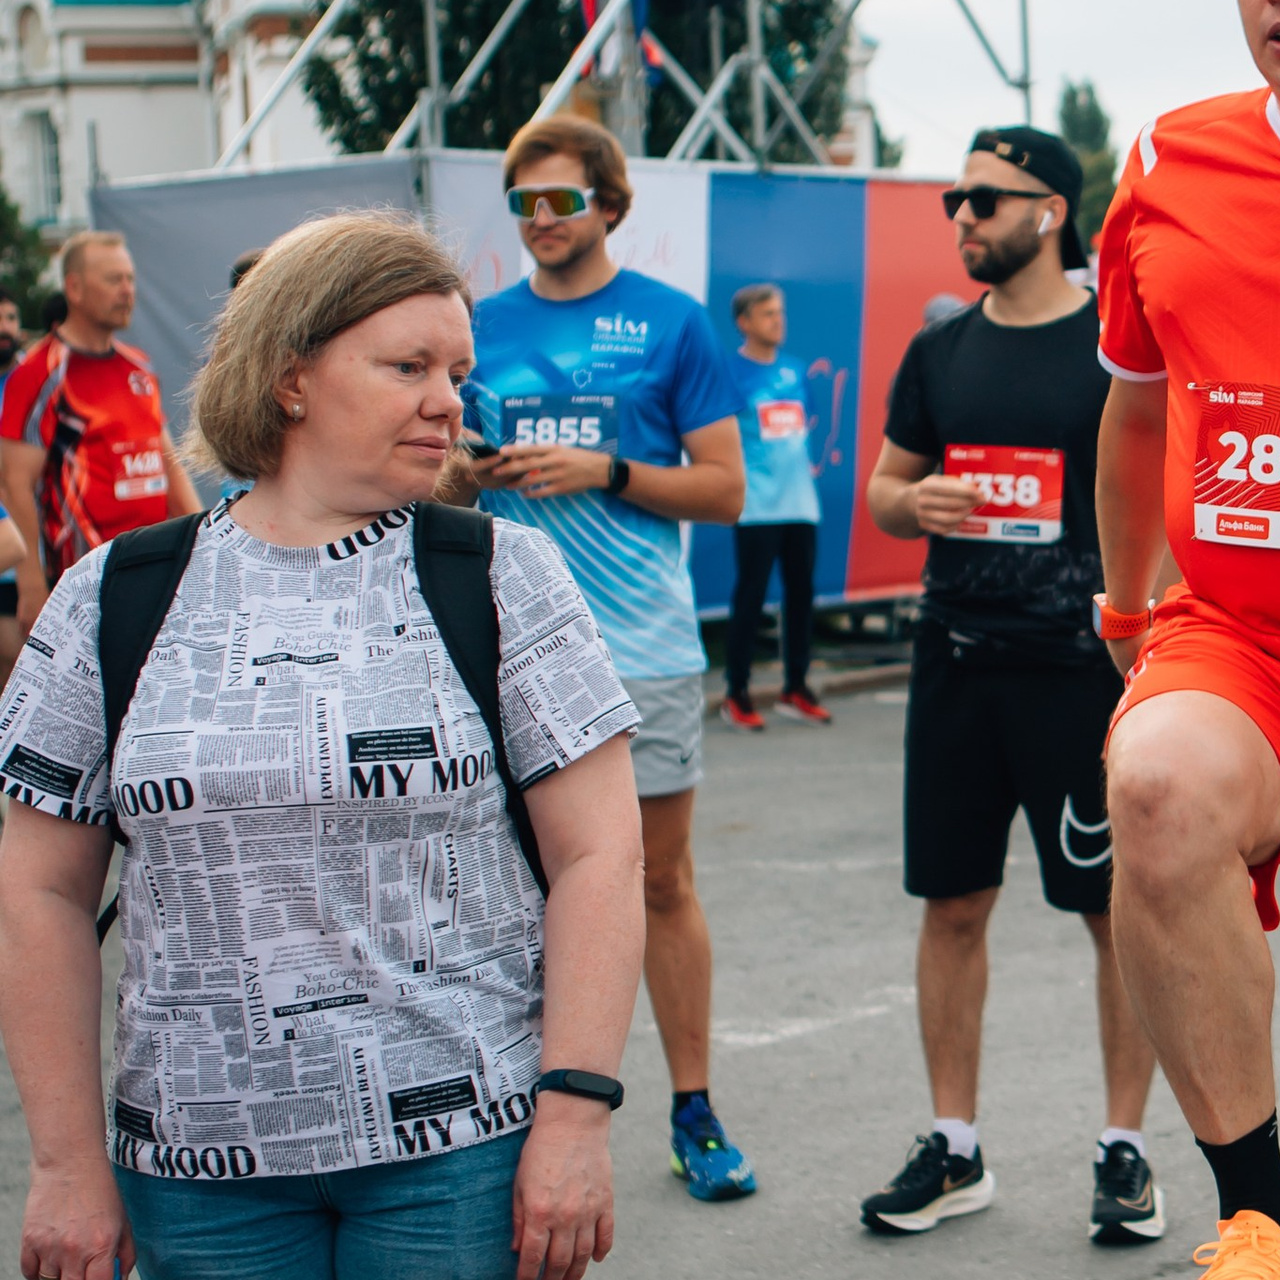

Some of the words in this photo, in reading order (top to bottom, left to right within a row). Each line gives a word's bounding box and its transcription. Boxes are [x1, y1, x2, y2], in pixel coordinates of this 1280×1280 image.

[515, 416, 601, 448] 5855
[1219, 518, 1243, 531] Альфа
[1243, 521, 1265, 533] Банк
[273, 636, 352, 653] Boho-Chic
[285, 631, 305, 642] You
[307, 630, 339, 640] Guide
[342, 632, 353, 640] to
[534, 633, 570, 661] Daily
[227, 611, 251, 687] FASHION
[256, 653, 288, 664] Voyage
[293, 653, 338, 664] interieur
[364, 644, 394, 658] The
[74, 657, 100, 680] The
[266, 664, 297, 676] What
[317, 696, 329, 733] BEAUTY
[318, 736, 334, 799] EXPECTANT
[349, 763, 414, 799] MY
[336, 798, 400, 810] INSPIRED
[403, 796, 419, 807] BY
[422, 794, 455, 805] ICONS
[444, 833, 459, 899] CHARTS
[304, 972, 327, 983] You
[329, 967, 363, 979] Guide
[365, 968, 378, 977] to
[295, 976, 380, 1000] Boho-Chic
[242, 956, 271, 1046] FASHION
[277, 1002, 313, 1015] Voyage
[320, 995, 367, 1008] interieur
[171, 1007, 203, 1023] Daily
[291, 1014, 328, 1029] What
[353, 1046, 370, 1092] BEAUTY
[361, 1096, 382, 1160] EXPECTANT
[393, 1114, 453, 1156] MY
[151, 1143, 256, 1179] MOOD
